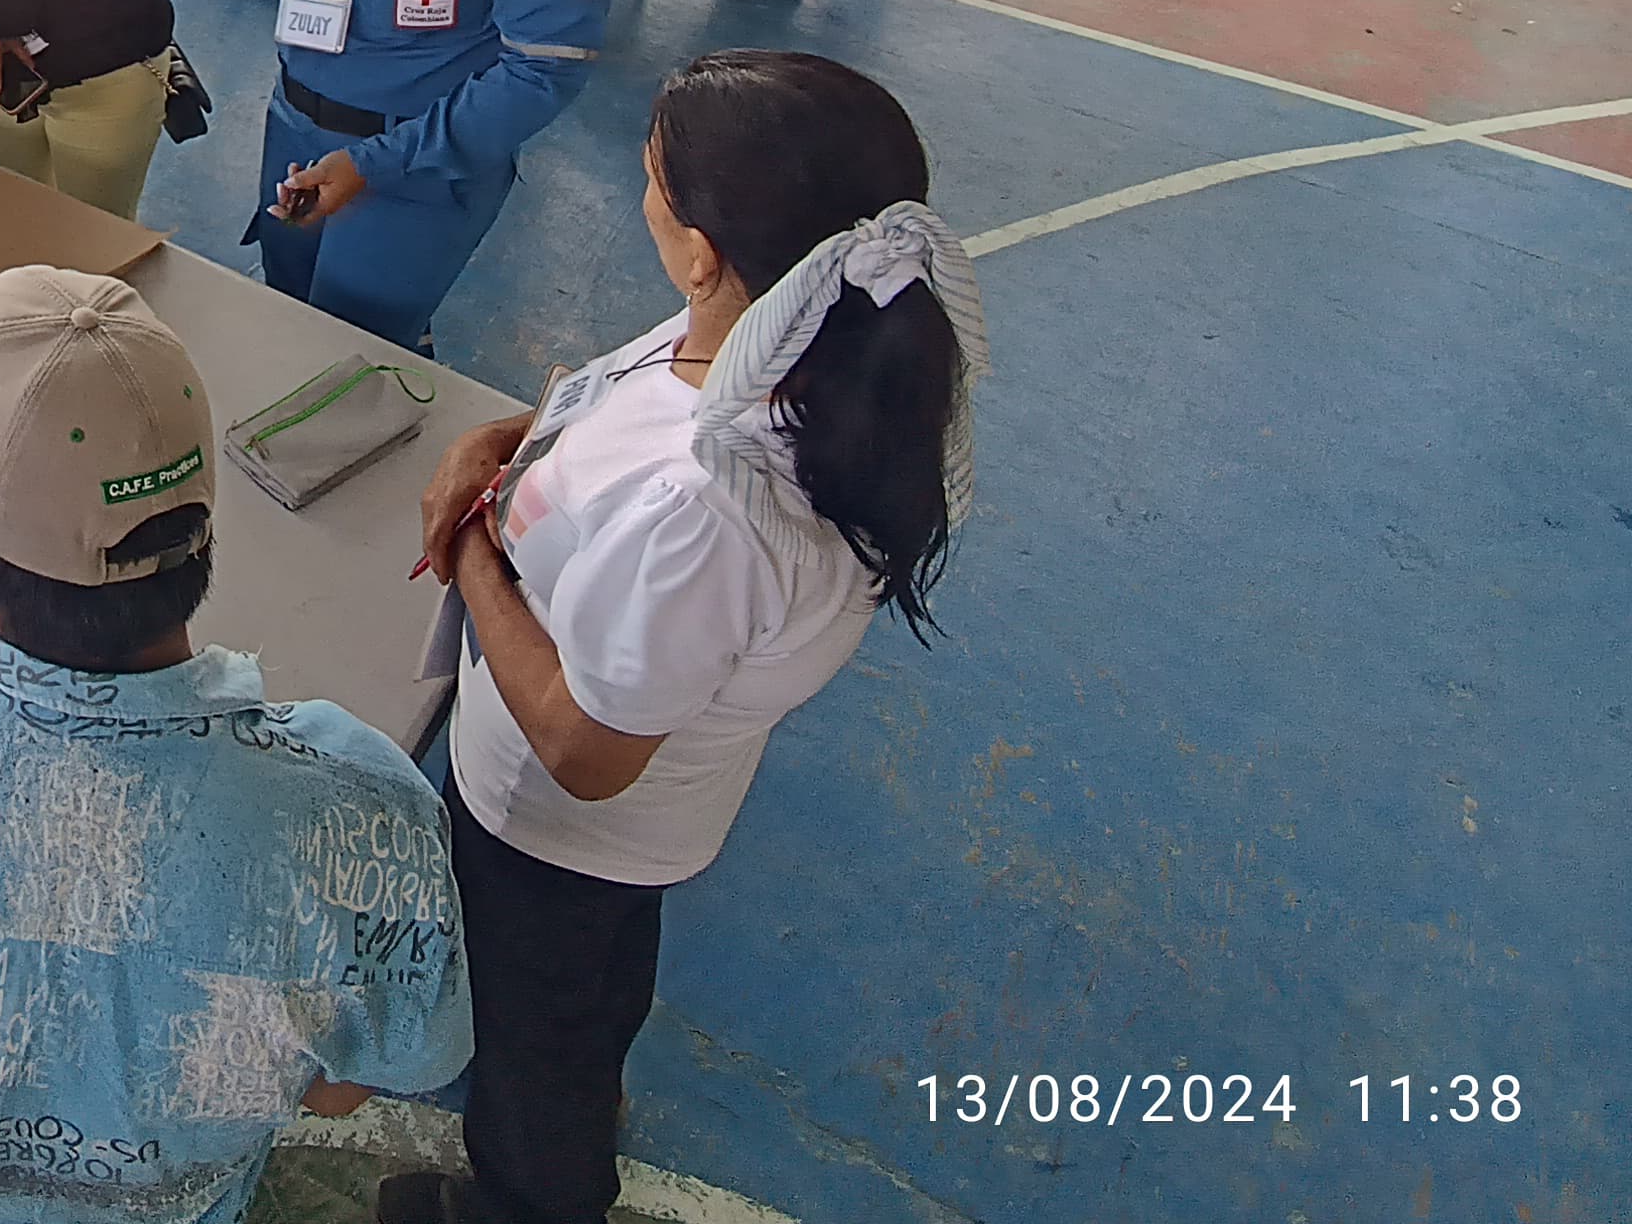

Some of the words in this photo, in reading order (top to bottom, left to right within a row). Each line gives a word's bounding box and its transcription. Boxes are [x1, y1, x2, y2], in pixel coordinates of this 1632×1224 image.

[400, 14, 451, 23] Colombiana
[404, 6, 425, 15] Cruz
[426, 6, 448, 16] Roja
[288, 11, 333, 36] ZULAY
[158, 455, 201, 486] Practices
